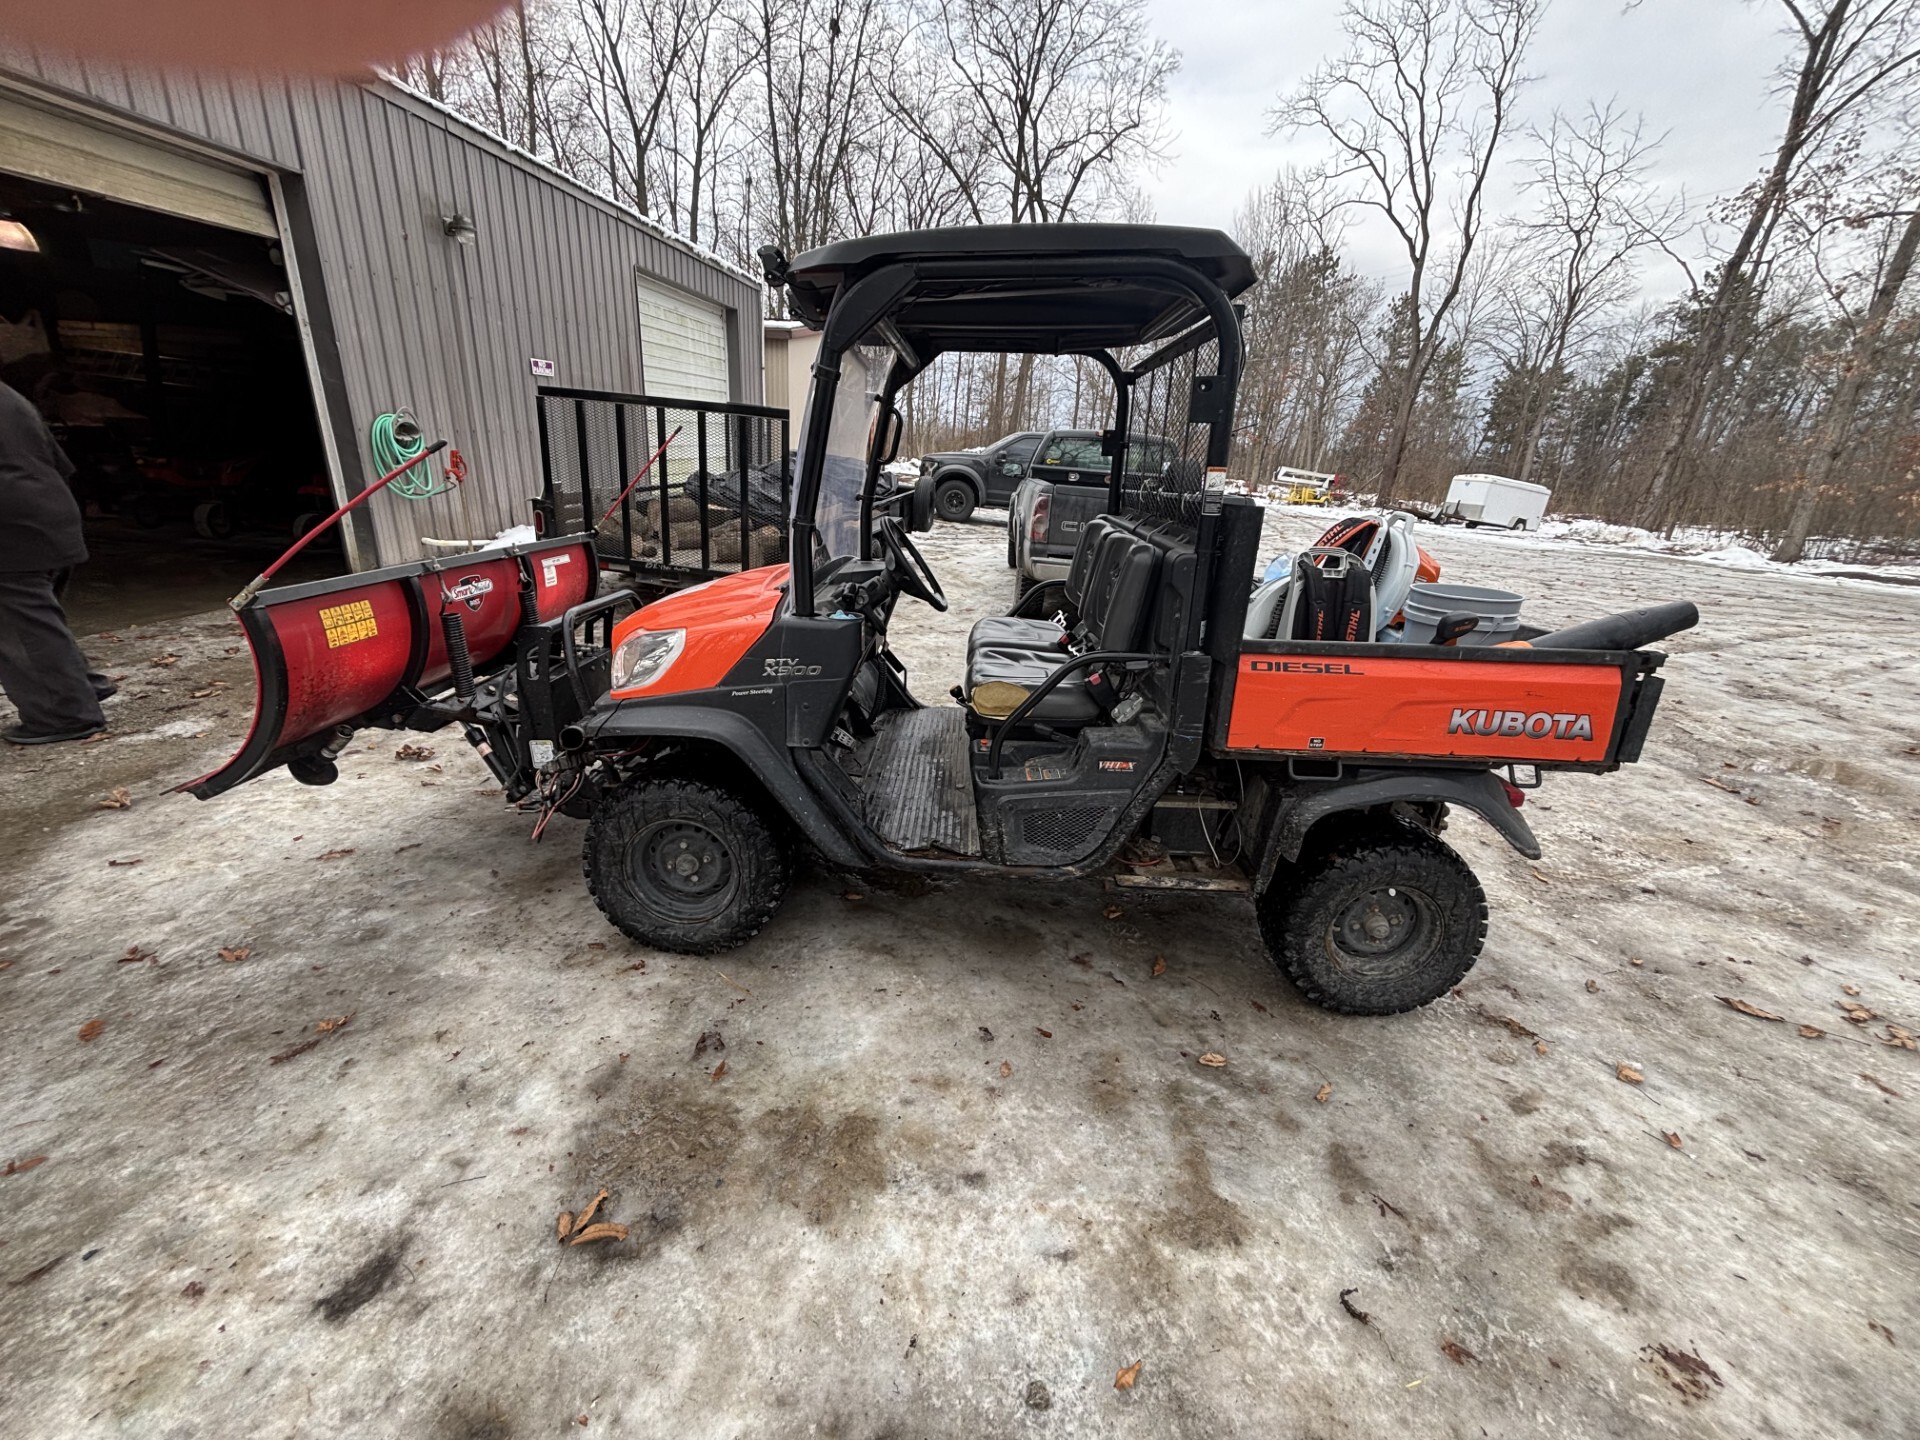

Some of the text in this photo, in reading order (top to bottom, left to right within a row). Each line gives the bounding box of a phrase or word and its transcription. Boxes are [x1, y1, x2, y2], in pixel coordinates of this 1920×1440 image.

[1317, 522, 1345, 547] STIHL
[1346, 610, 1361, 642] STIHL
[764, 658, 800, 667] RTV
[1250, 660, 1365, 676] DIESEL
[762, 665, 822, 677] X900
[749, 687, 774, 695] Steering
[1447, 707, 1594, 741] KUBOTA
